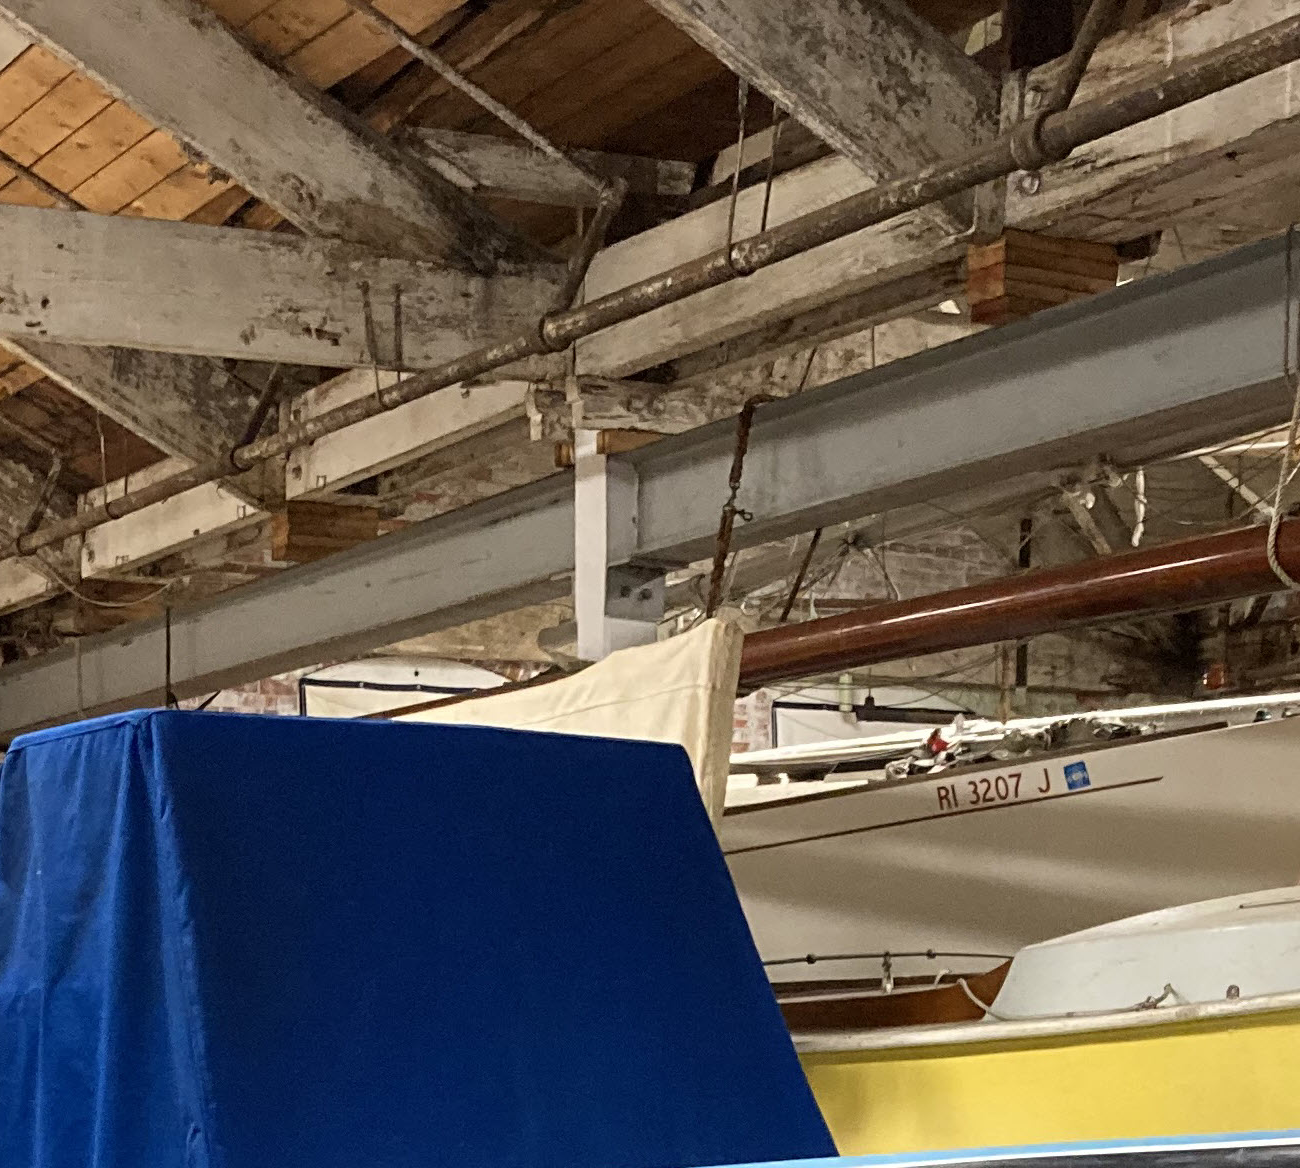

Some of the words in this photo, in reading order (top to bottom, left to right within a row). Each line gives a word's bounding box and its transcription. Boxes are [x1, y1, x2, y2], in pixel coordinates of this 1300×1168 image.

[936, 784, 959, 811] RI
[967, 772, 1022, 805] 3207
[1038, 768, 1051, 794] J
